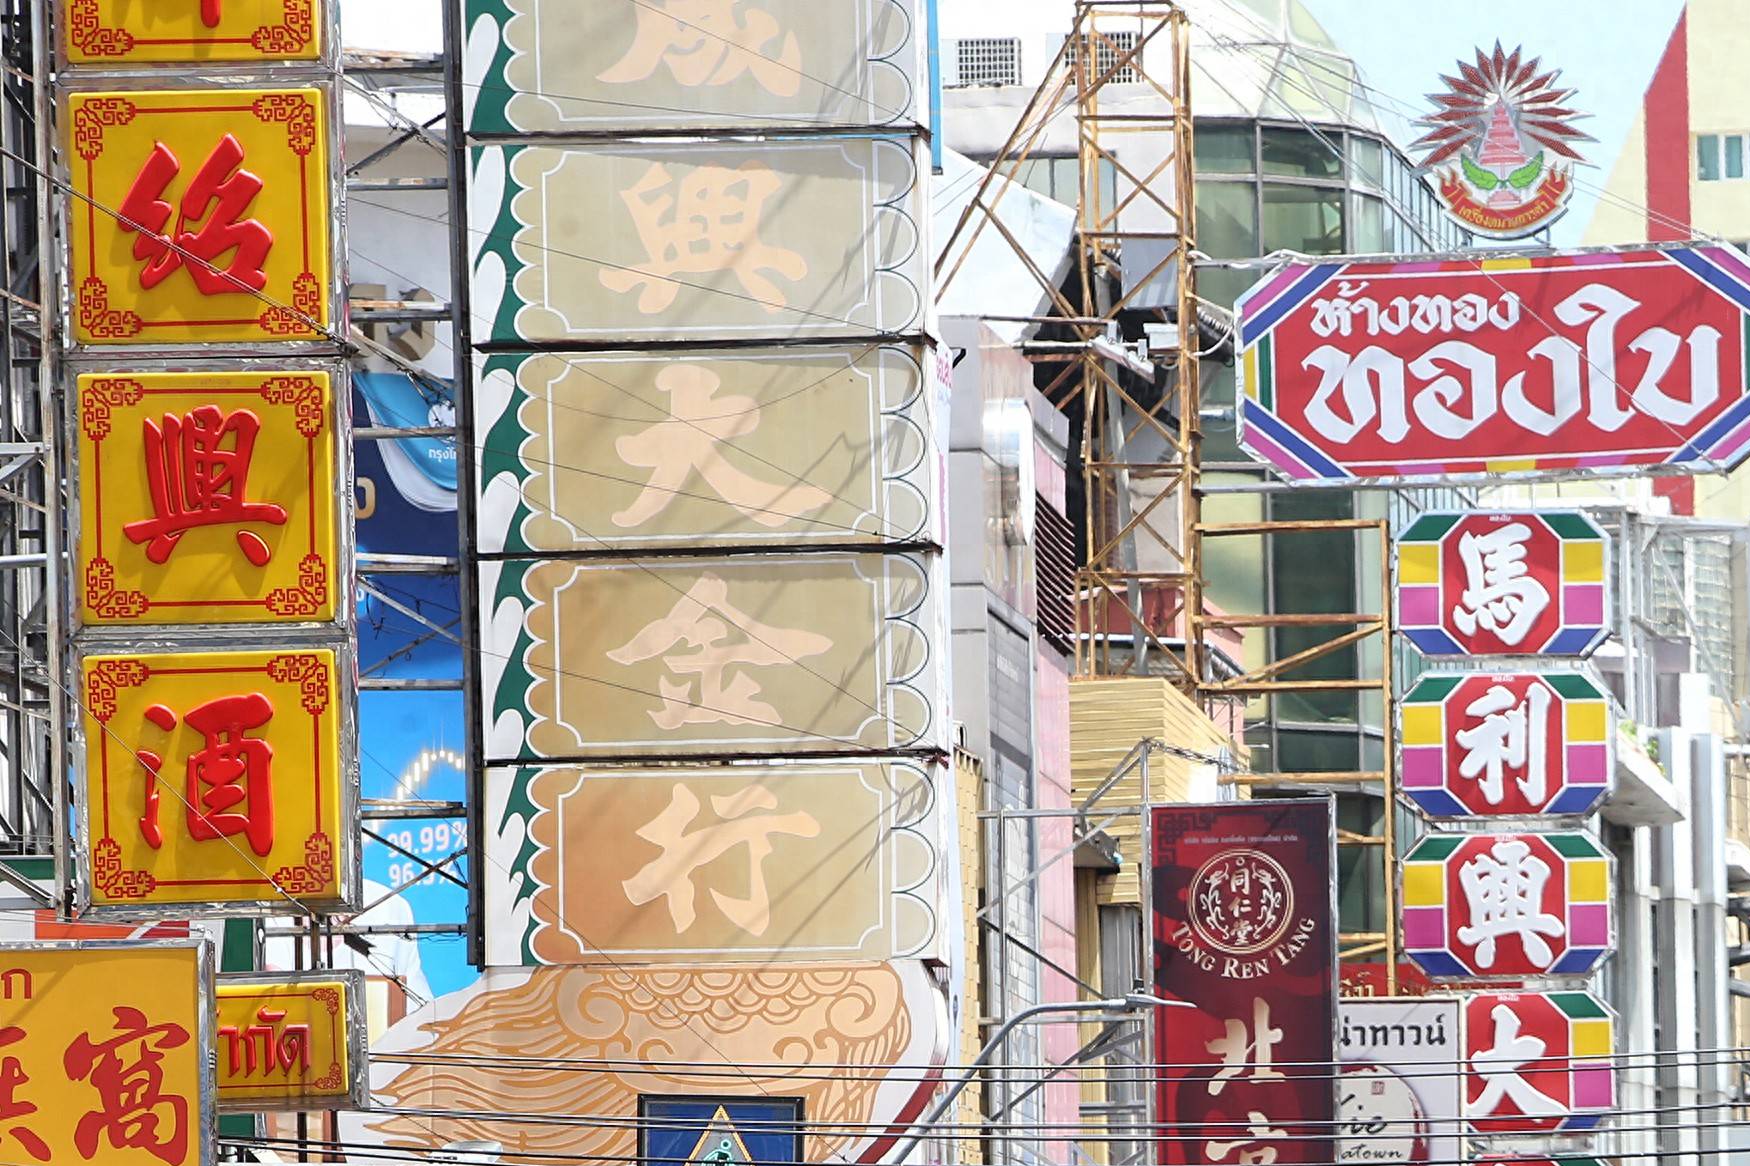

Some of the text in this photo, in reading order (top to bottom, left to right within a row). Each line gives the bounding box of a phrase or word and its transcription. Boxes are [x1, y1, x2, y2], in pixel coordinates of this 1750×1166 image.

[1311, 281, 1521, 338] ห้างทอง
[1300, 283, 1723, 445] ทองใบ
[1228, 867, 1253, 946] 同仁堂
[1171, 917, 1316, 980] TONG REN TANG
